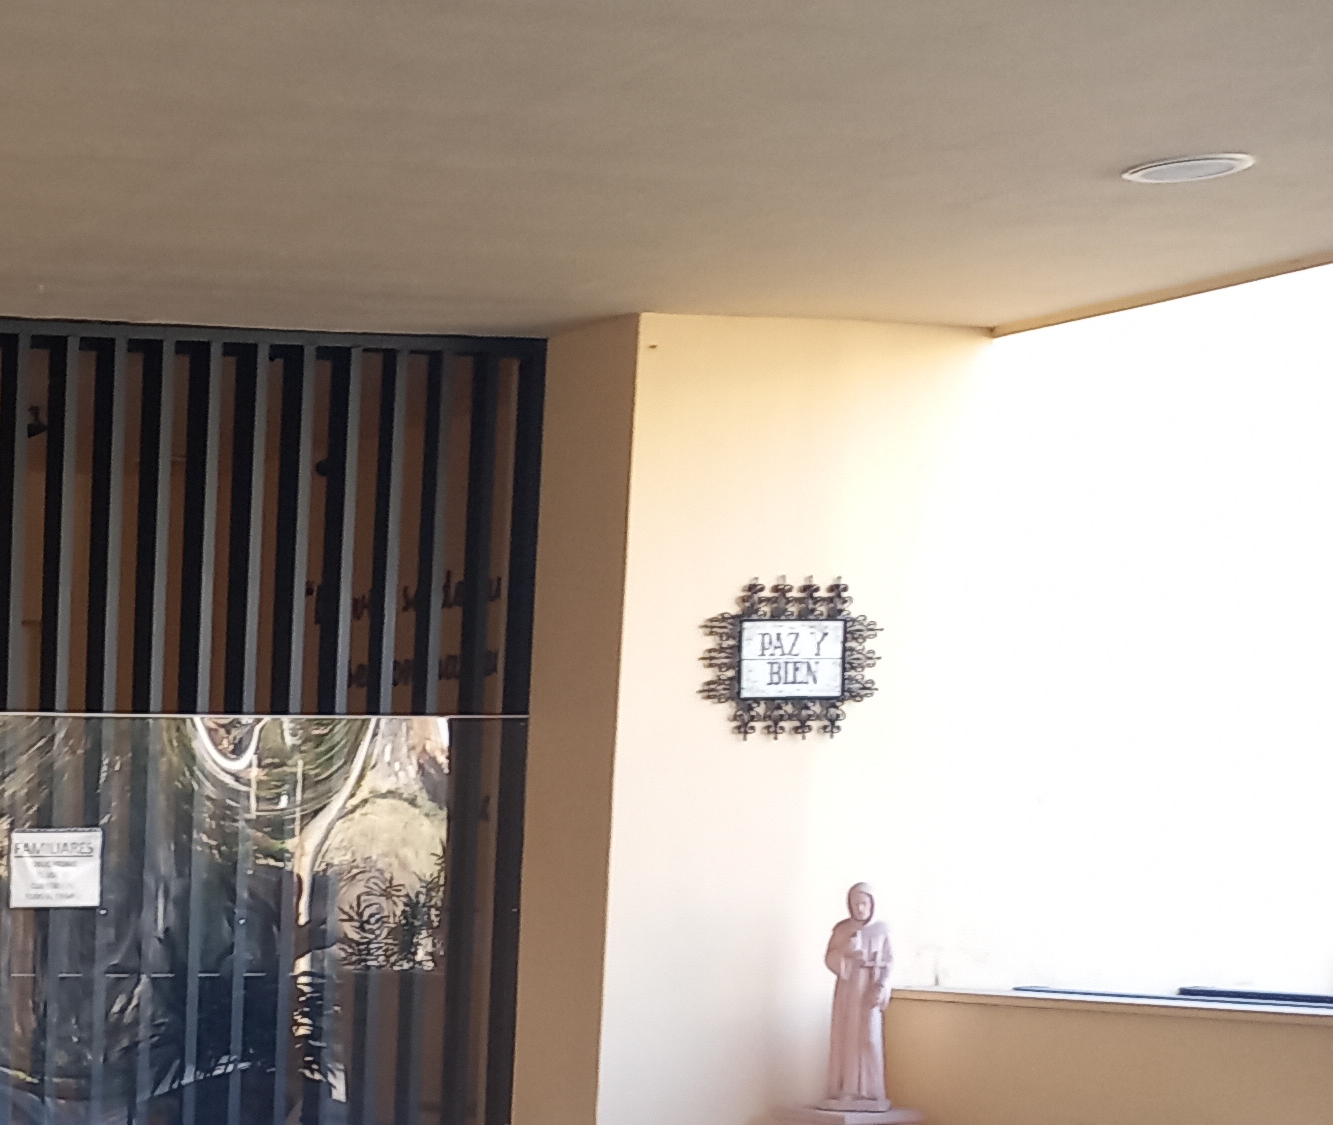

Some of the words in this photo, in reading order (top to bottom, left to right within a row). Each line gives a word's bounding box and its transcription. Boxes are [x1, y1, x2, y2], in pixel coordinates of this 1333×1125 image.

[758, 632, 800, 656] PAZ
[810, 632, 829, 656] Y
[767, 661, 820, 685] BIEN
